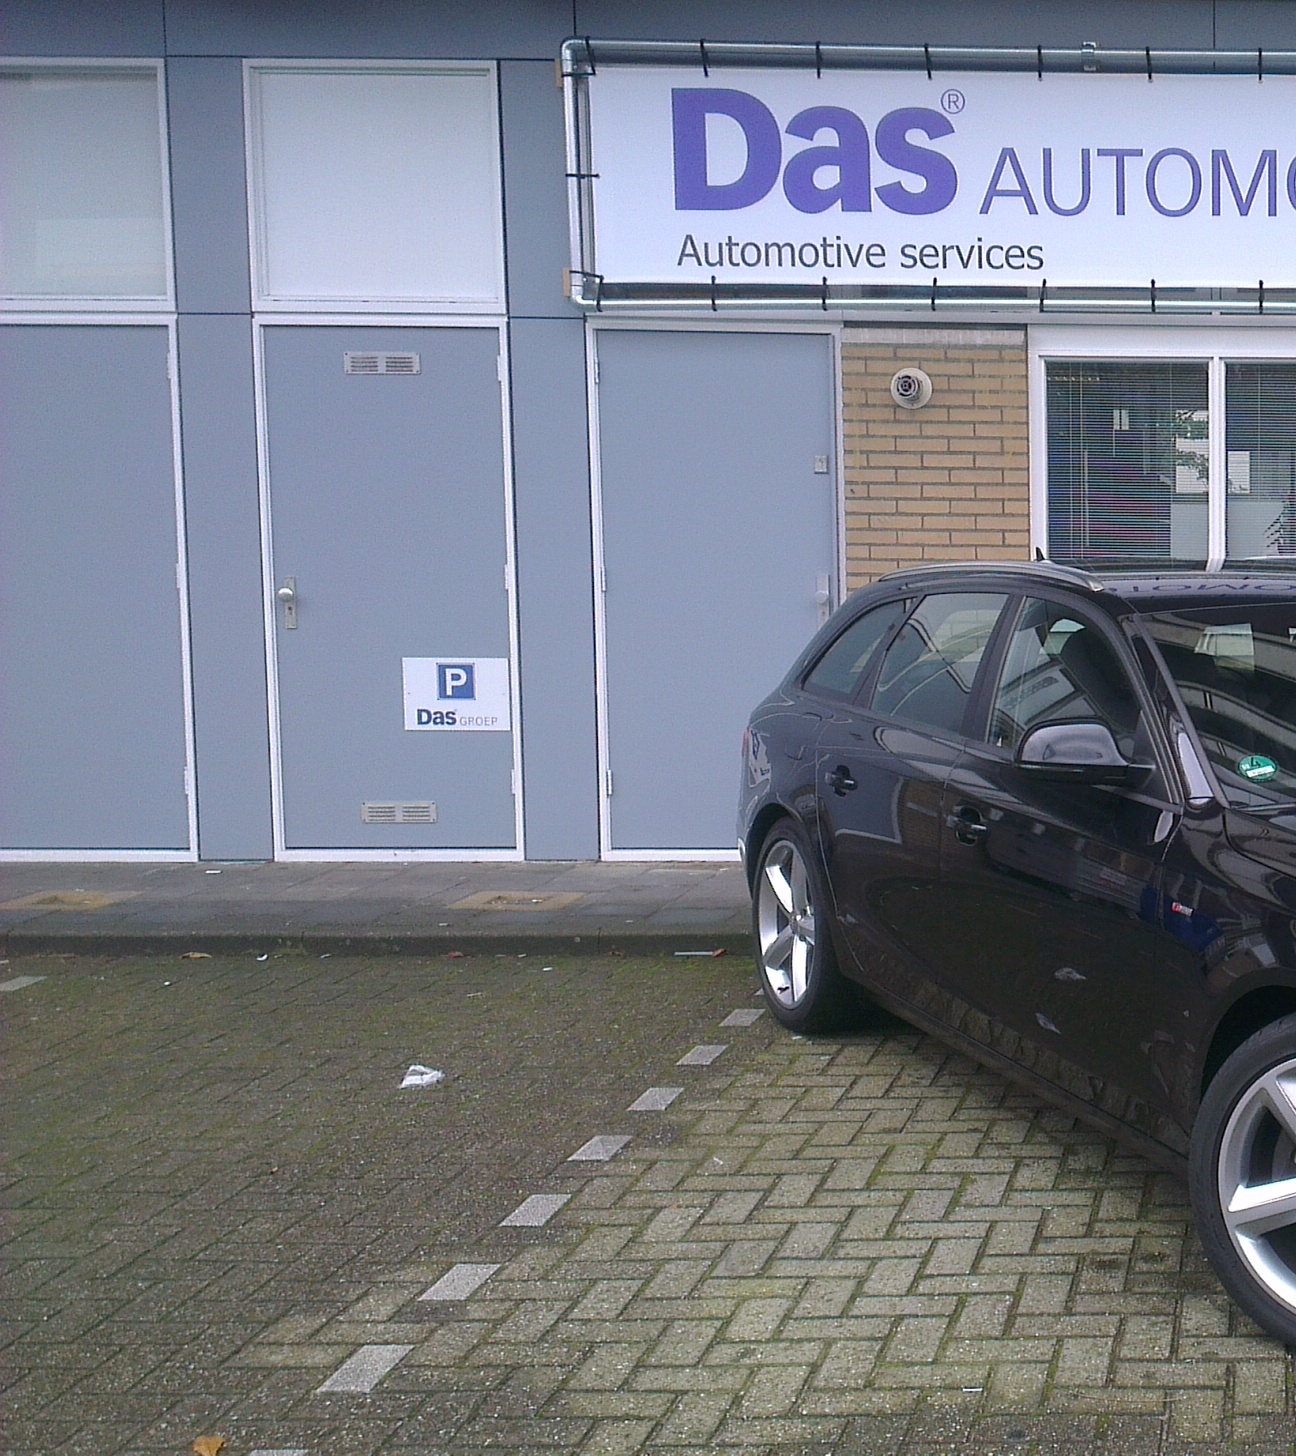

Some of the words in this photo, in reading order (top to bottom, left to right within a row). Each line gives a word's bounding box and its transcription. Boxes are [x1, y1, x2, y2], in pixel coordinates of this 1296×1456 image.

[677, 233, 886, 268] Automotive
[900, 236, 1044, 270] services
[445, 668, 467, 696] P
[417, 708, 457, 726] Das
[459, 716, 498, 726] GROEP
